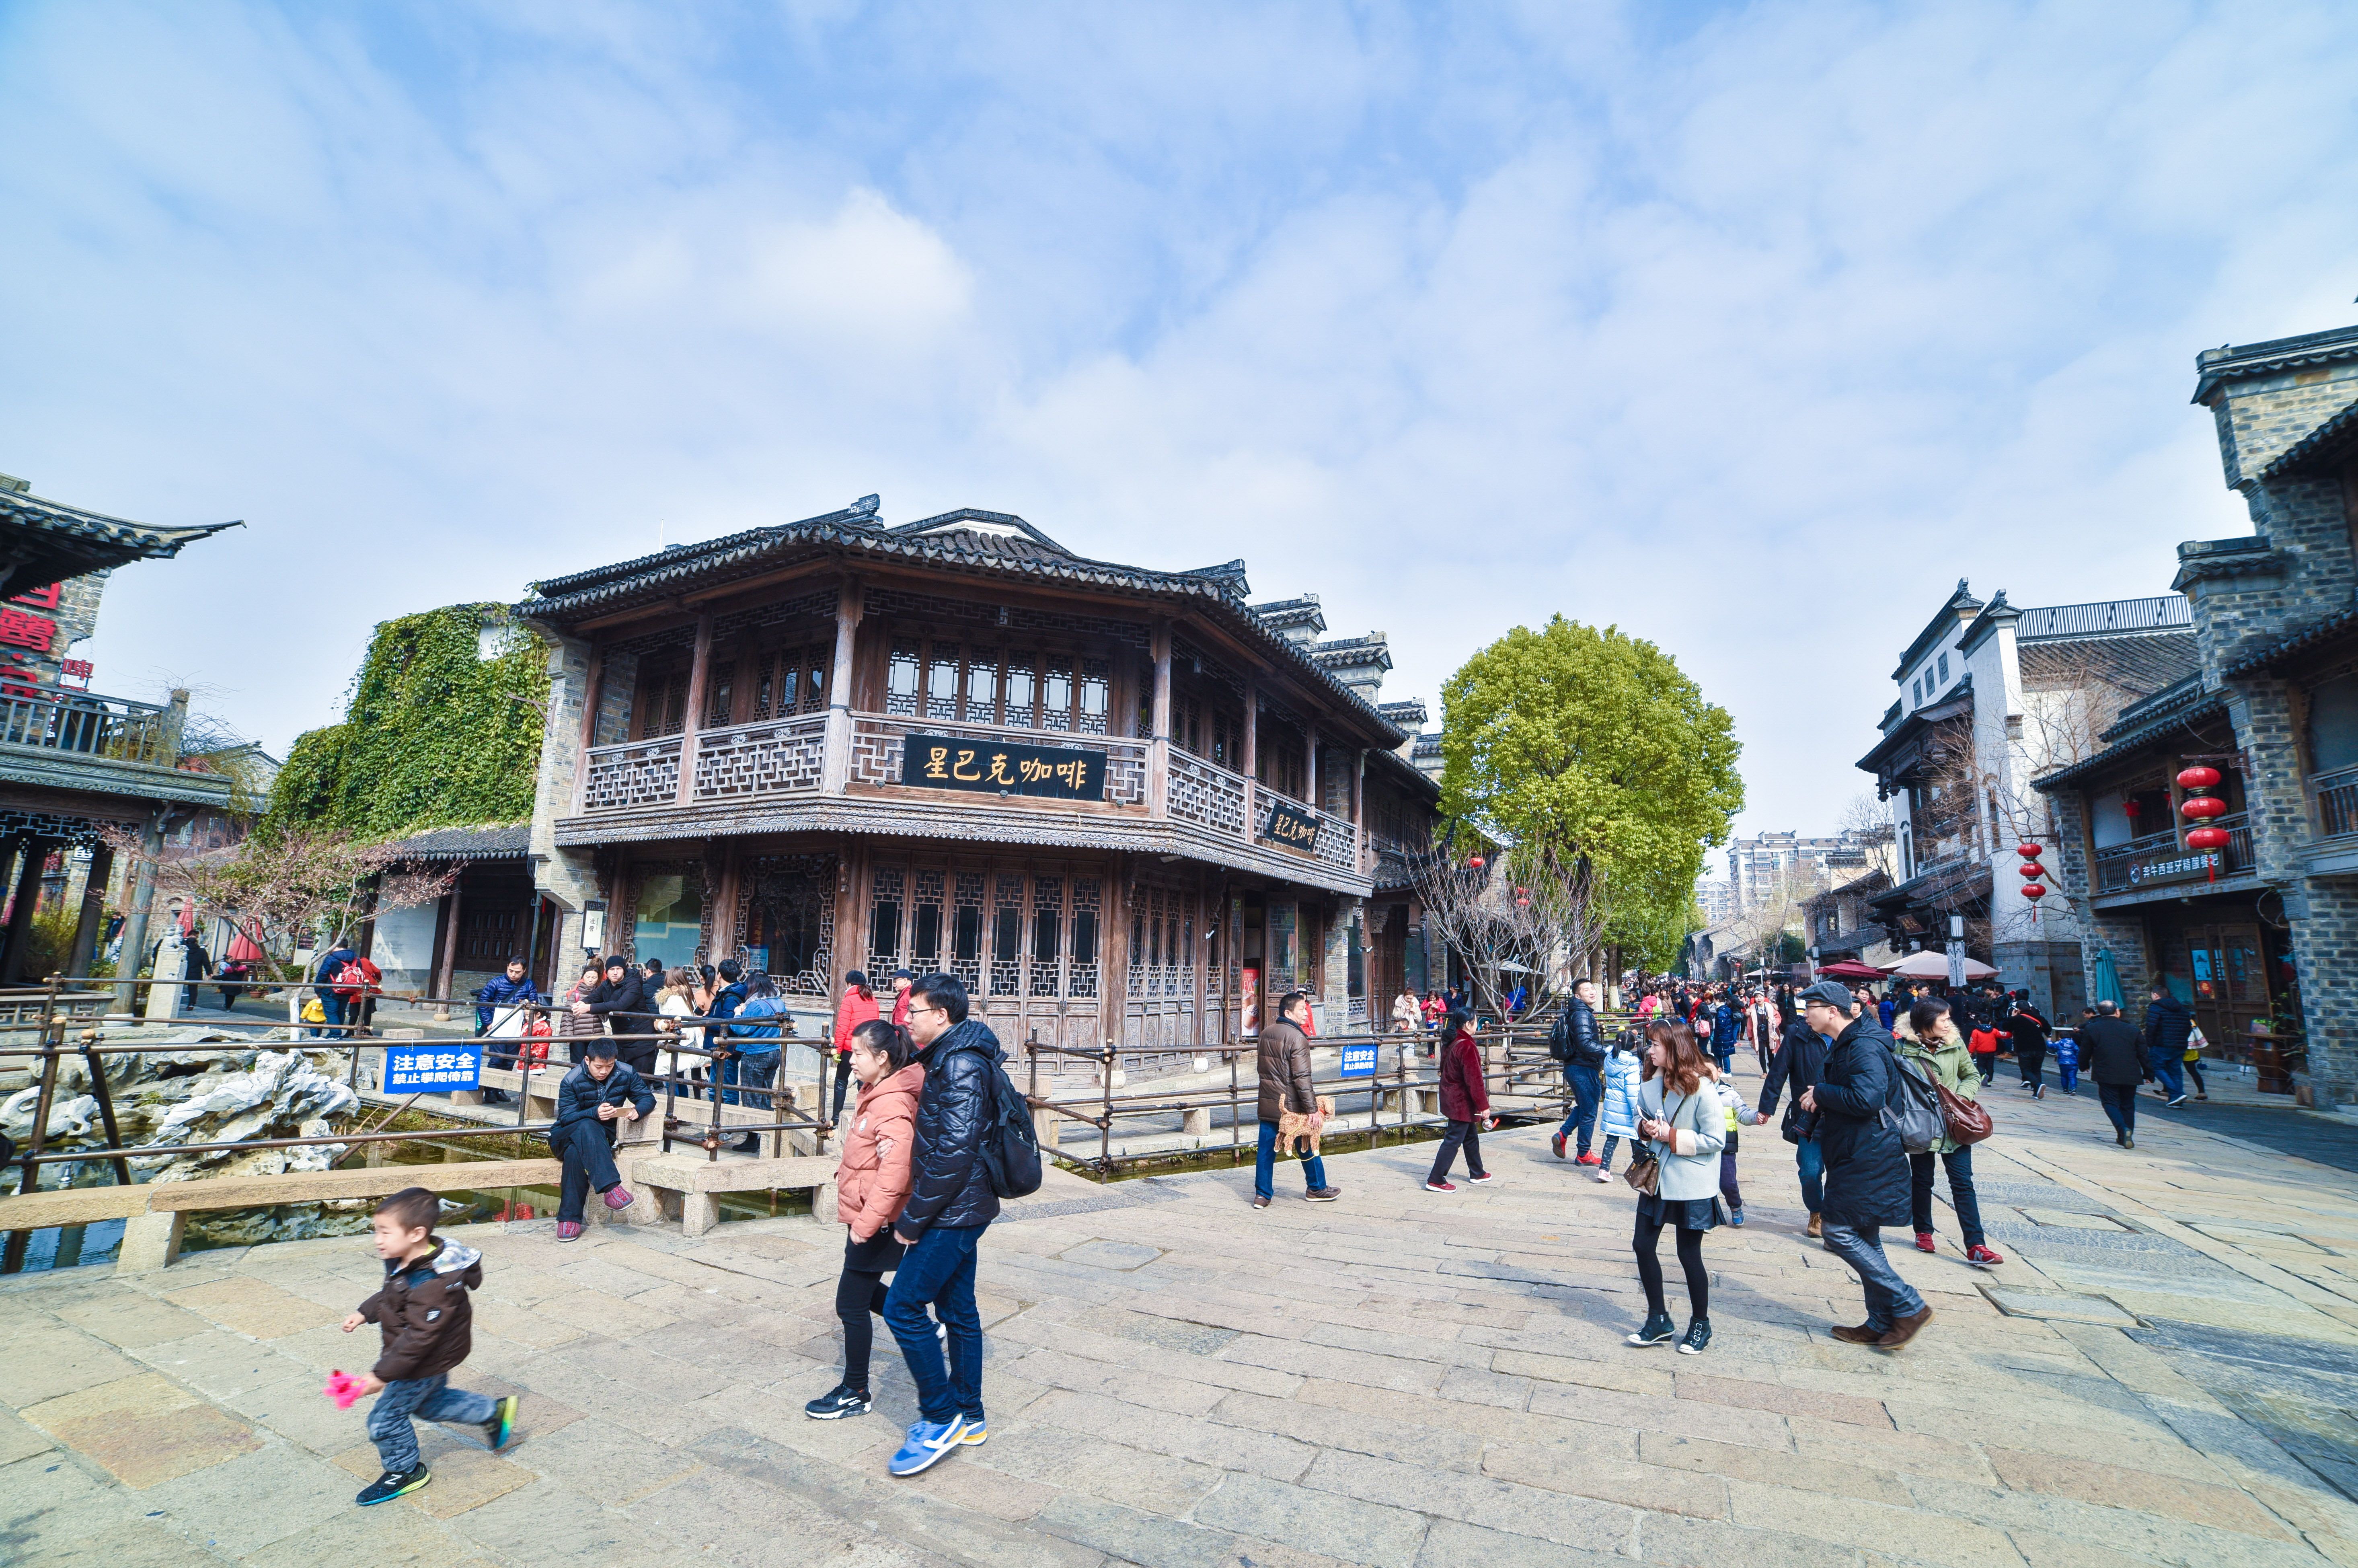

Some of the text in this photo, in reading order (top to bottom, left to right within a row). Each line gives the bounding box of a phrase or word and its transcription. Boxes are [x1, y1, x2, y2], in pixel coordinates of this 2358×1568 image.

[924, 748, 1087, 790] 星巴克咖啡
[1274, 814, 1315, 845] 星巴克咖啡
[393, 1053, 475, 1071] 注意安全
[1344, 1050, 1375, 1062] 注意安全
[392, 1071, 474, 1085] 禁止攀爬倚靠
